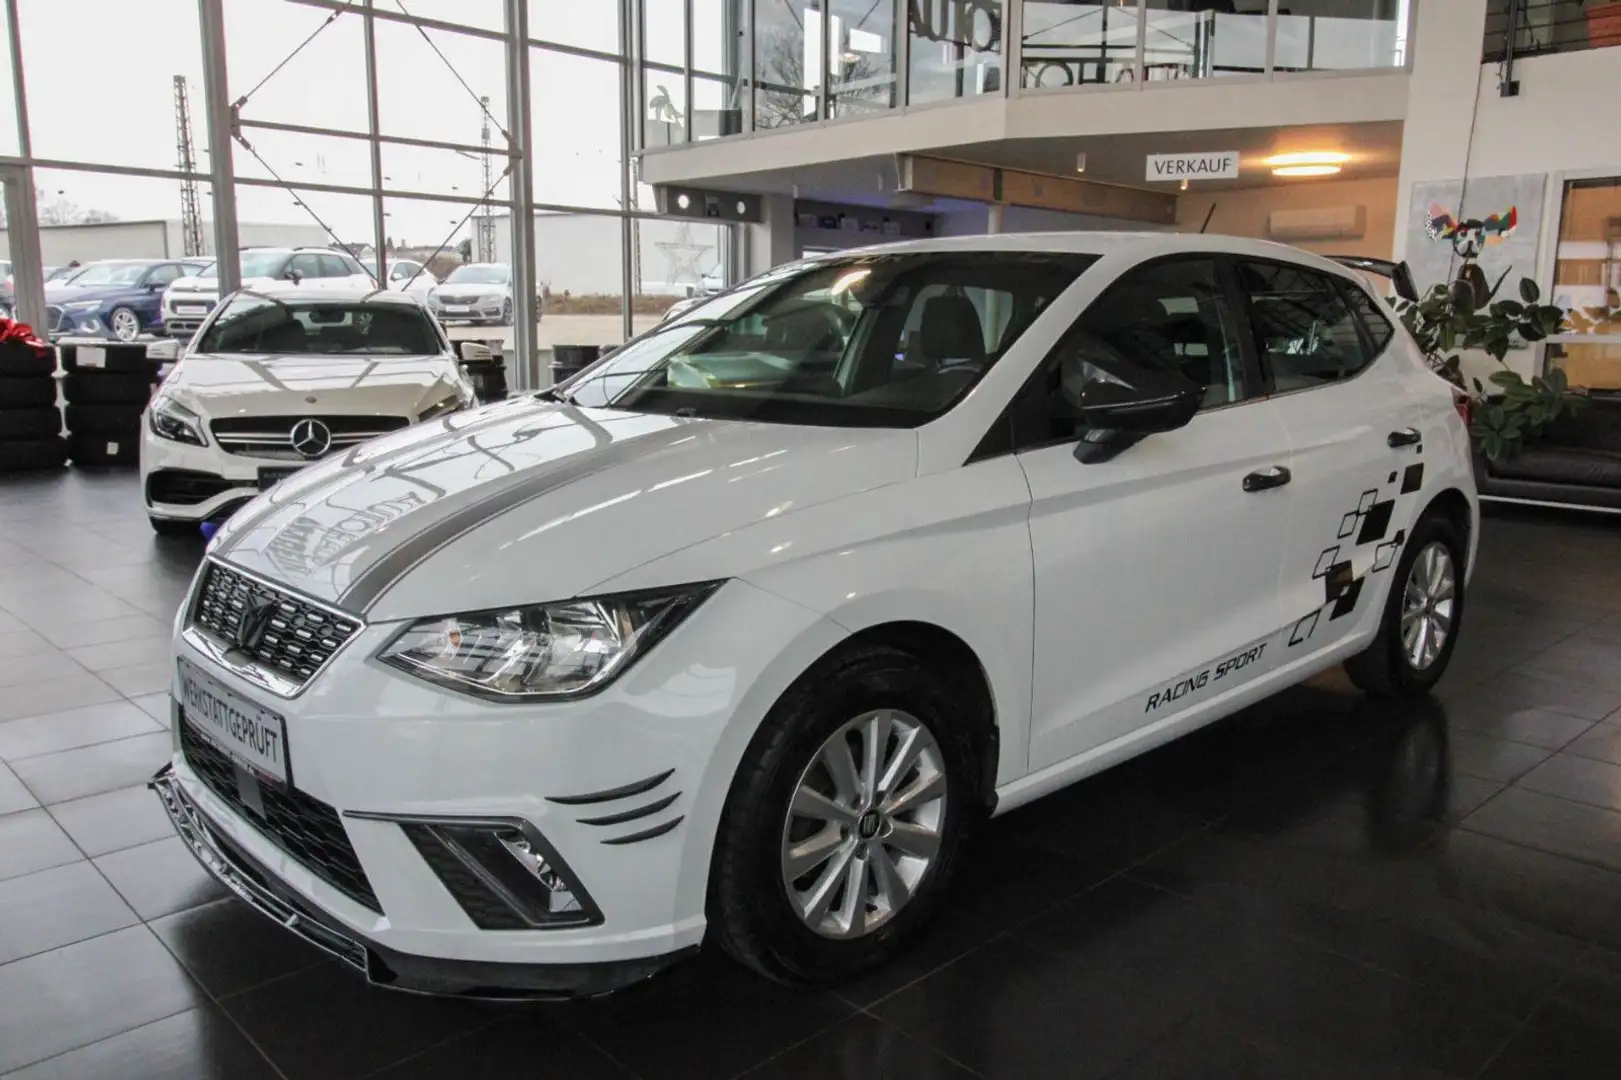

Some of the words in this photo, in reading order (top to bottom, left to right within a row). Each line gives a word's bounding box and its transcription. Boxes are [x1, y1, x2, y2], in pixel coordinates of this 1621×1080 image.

[1154, 157, 1232, 174] VERKAUF
[1145, 670, 1209, 713] RACING
[1213, 643, 1267, 681] SPORT
